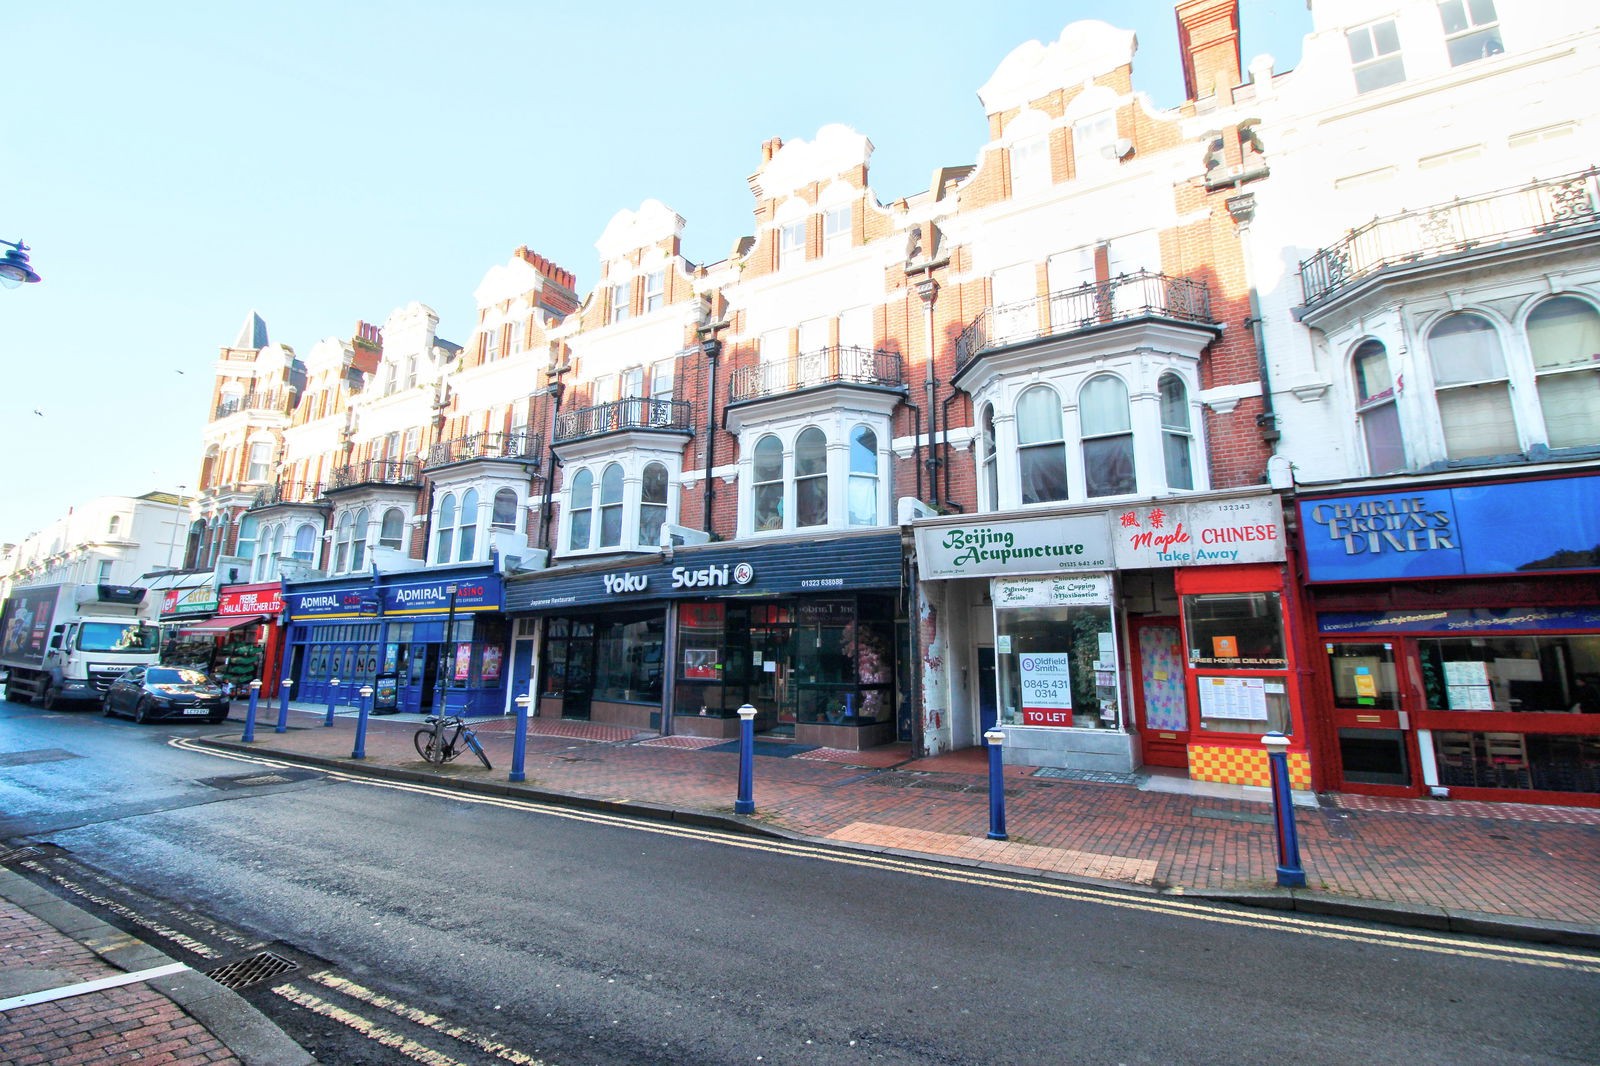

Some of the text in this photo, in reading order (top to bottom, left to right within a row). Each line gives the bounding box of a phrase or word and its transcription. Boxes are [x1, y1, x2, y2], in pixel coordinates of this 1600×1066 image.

[1312, 497, 1426, 525] CHARLIE
[942, 528, 1014, 549] Beijing
[1130, 523, 1278, 553] Maple CHINESE
[1345, 528, 1456, 555] DINER
[953, 543, 1084, 566] Acupuncture
[1156, 548, 1238, 562] Take Away
[603, 572, 648, 593] Yoku
[671, 564, 729, 588] Sushi
[801, 579, 820, 587] 01323
[457, 586, 484, 596] ASINO
[1067, 583, 1095, 591] Cupping
[300, 594, 339, 609] ADMIRAL
[396, 586, 446, 603] ADMIRAL
[551, 596, 576, 604] Restaurant
[1053, 592, 1098, 600] Moxibustion
[223, 601, 280, 613] HALAL BUTCHER LTD
[310, 658, 376, 672] CASINO
[1035, 664, 1058, 672] Smith
[1023, 680, 1068, 689] 0845 431
[1034, 689, 1057, 698] 0314
[1028, 711, 1066, 722] TO LET
